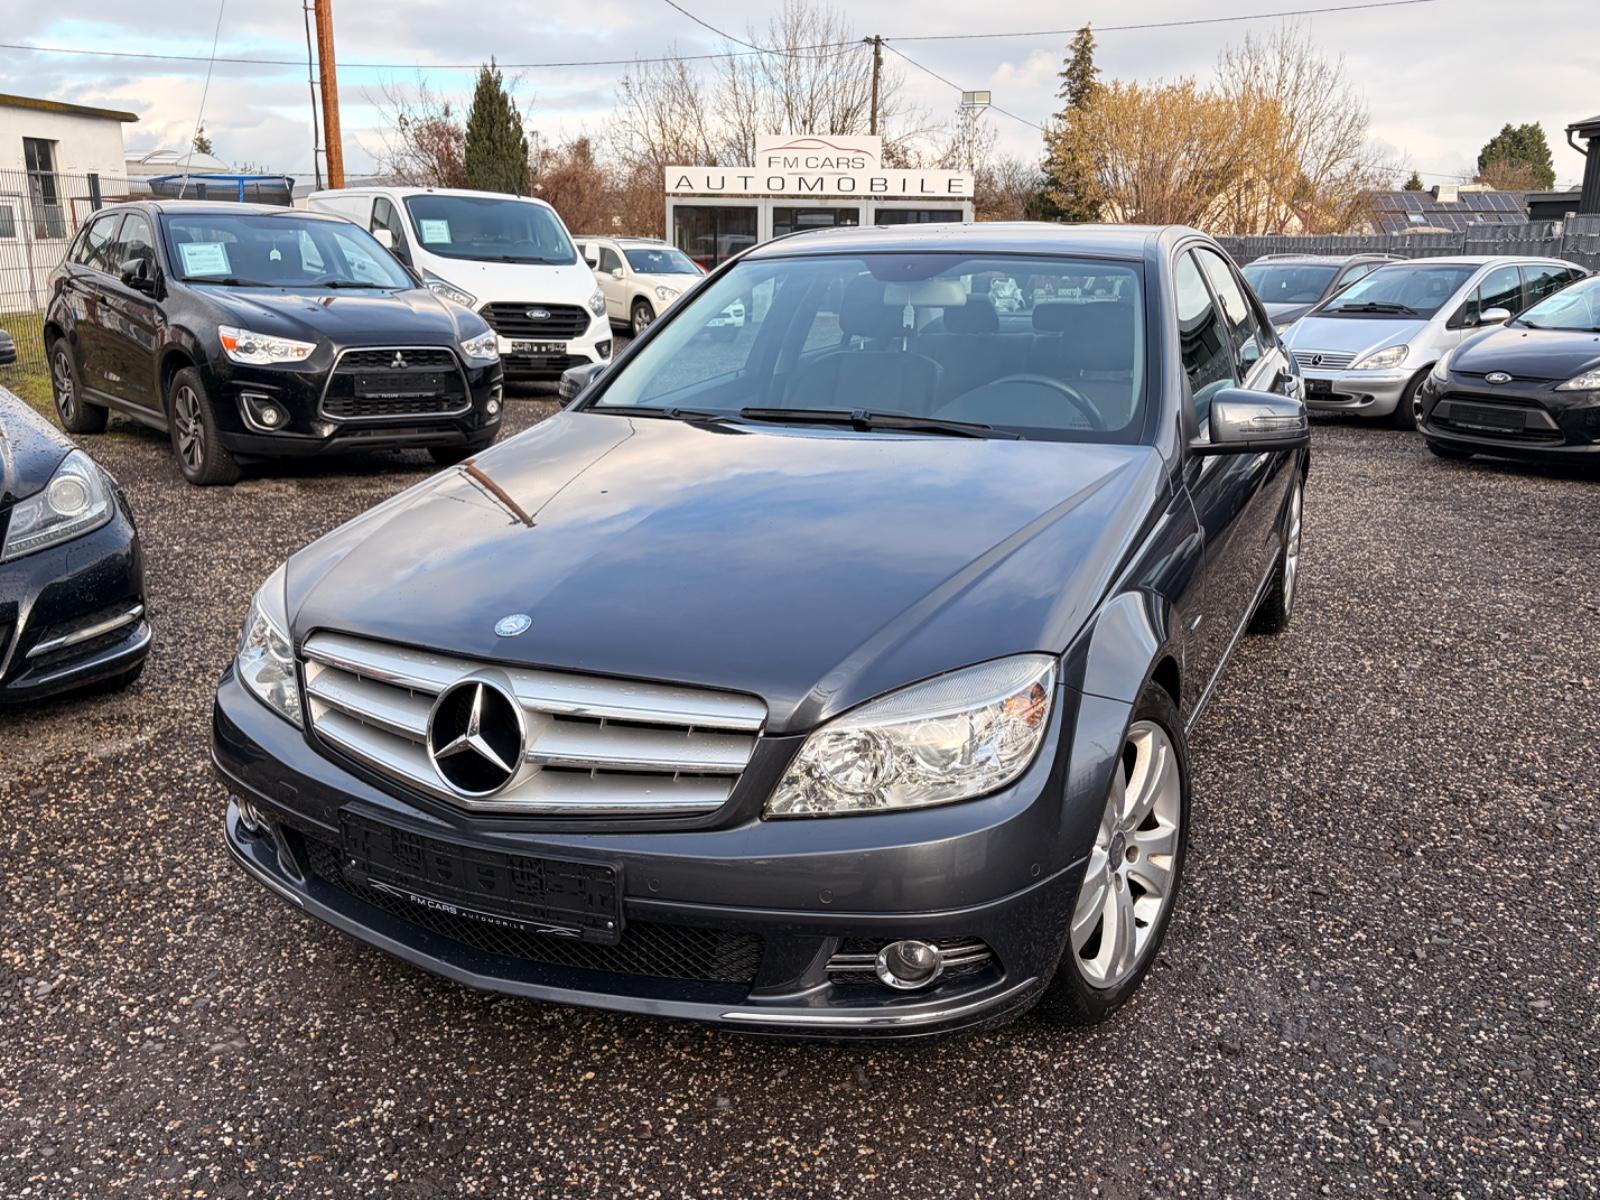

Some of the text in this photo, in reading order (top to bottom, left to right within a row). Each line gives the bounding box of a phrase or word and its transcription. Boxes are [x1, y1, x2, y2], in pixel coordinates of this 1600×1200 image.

[767, 156, 865, 169] FM CARS
[675, 174, 965, 195] AUTOMOBILE
[410, 895, 526, 931] FM CARS AUTOMOBILE
